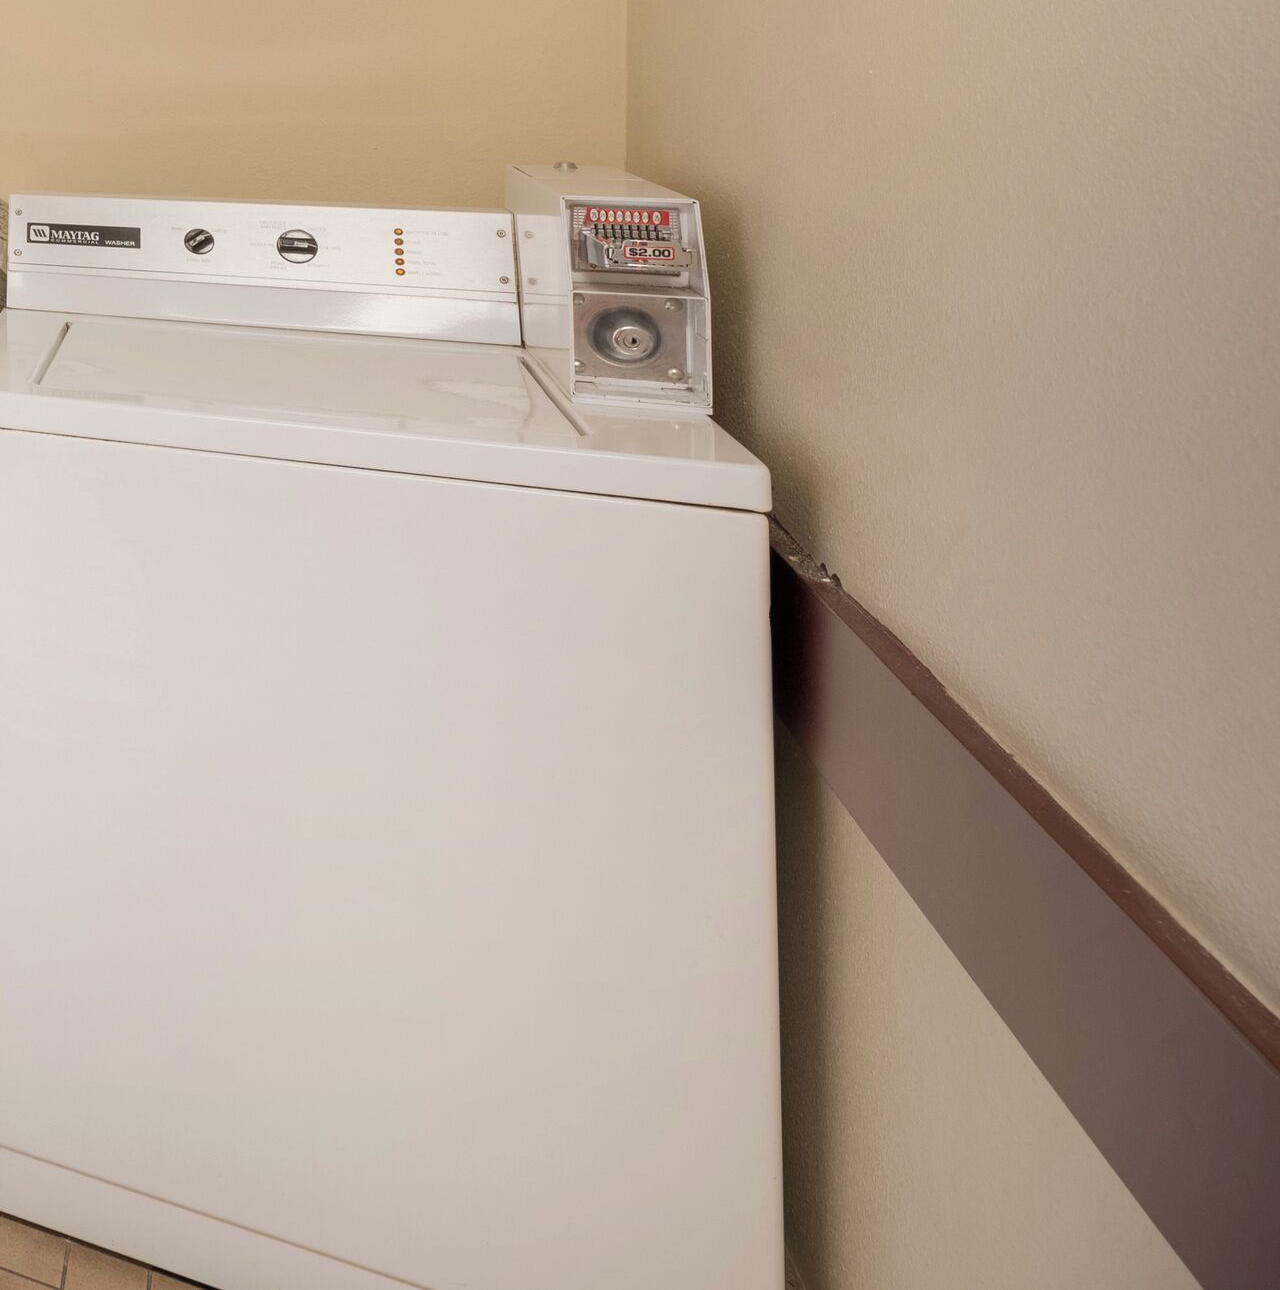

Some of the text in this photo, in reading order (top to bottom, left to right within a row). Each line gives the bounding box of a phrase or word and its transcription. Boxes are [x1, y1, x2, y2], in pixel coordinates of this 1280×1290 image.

[50, 229, 100, 241] MAYTAG
[104, 239, 136, 247] WASHER
[628, 247, 671, 258] $2.00
